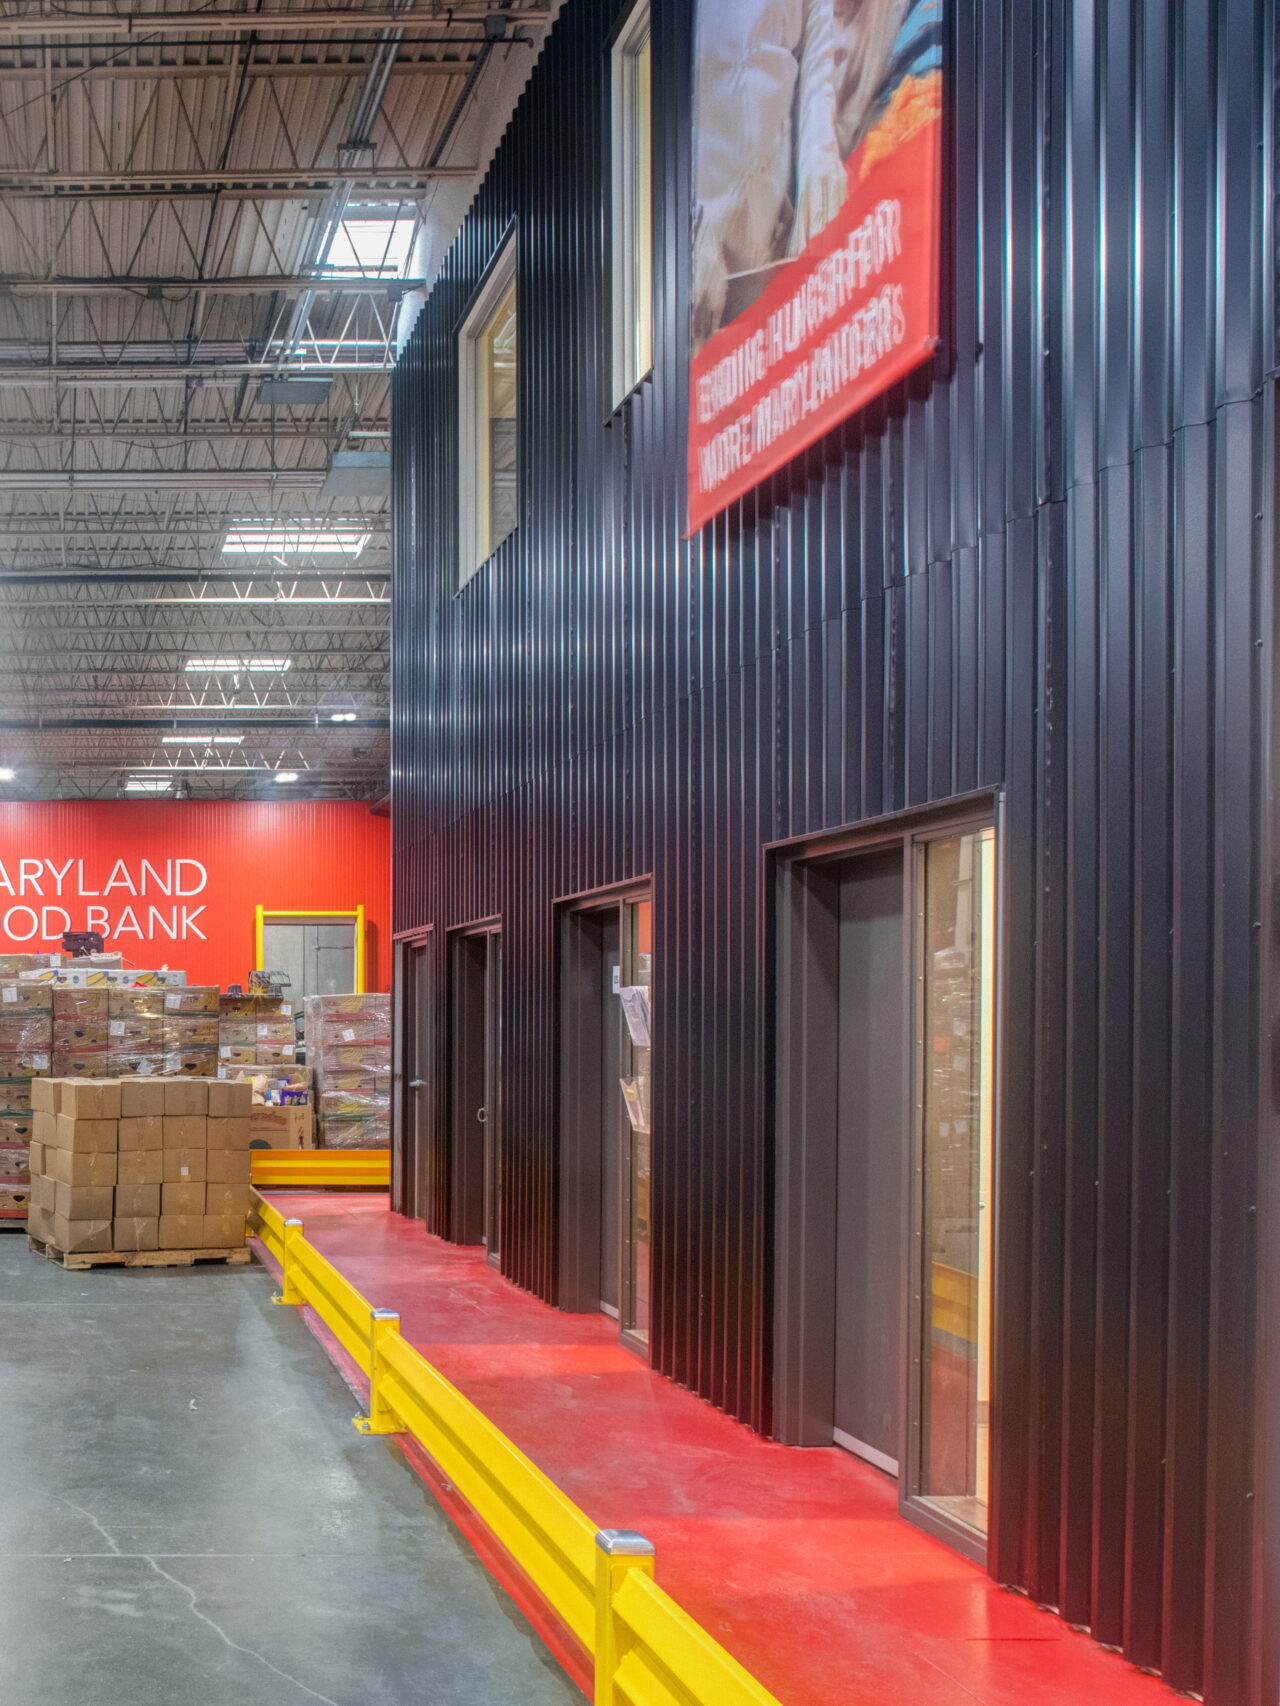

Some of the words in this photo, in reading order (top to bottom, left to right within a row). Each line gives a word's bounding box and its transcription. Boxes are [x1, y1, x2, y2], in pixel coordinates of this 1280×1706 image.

[767, 248, 851, 367] HUNGER
[848, 199, 902, 289] FOR
[698, 414, 752, 493] MORE
[751, 284, 906, 455] MARYLANDERS
[87, 905, 208, 941] BANK
